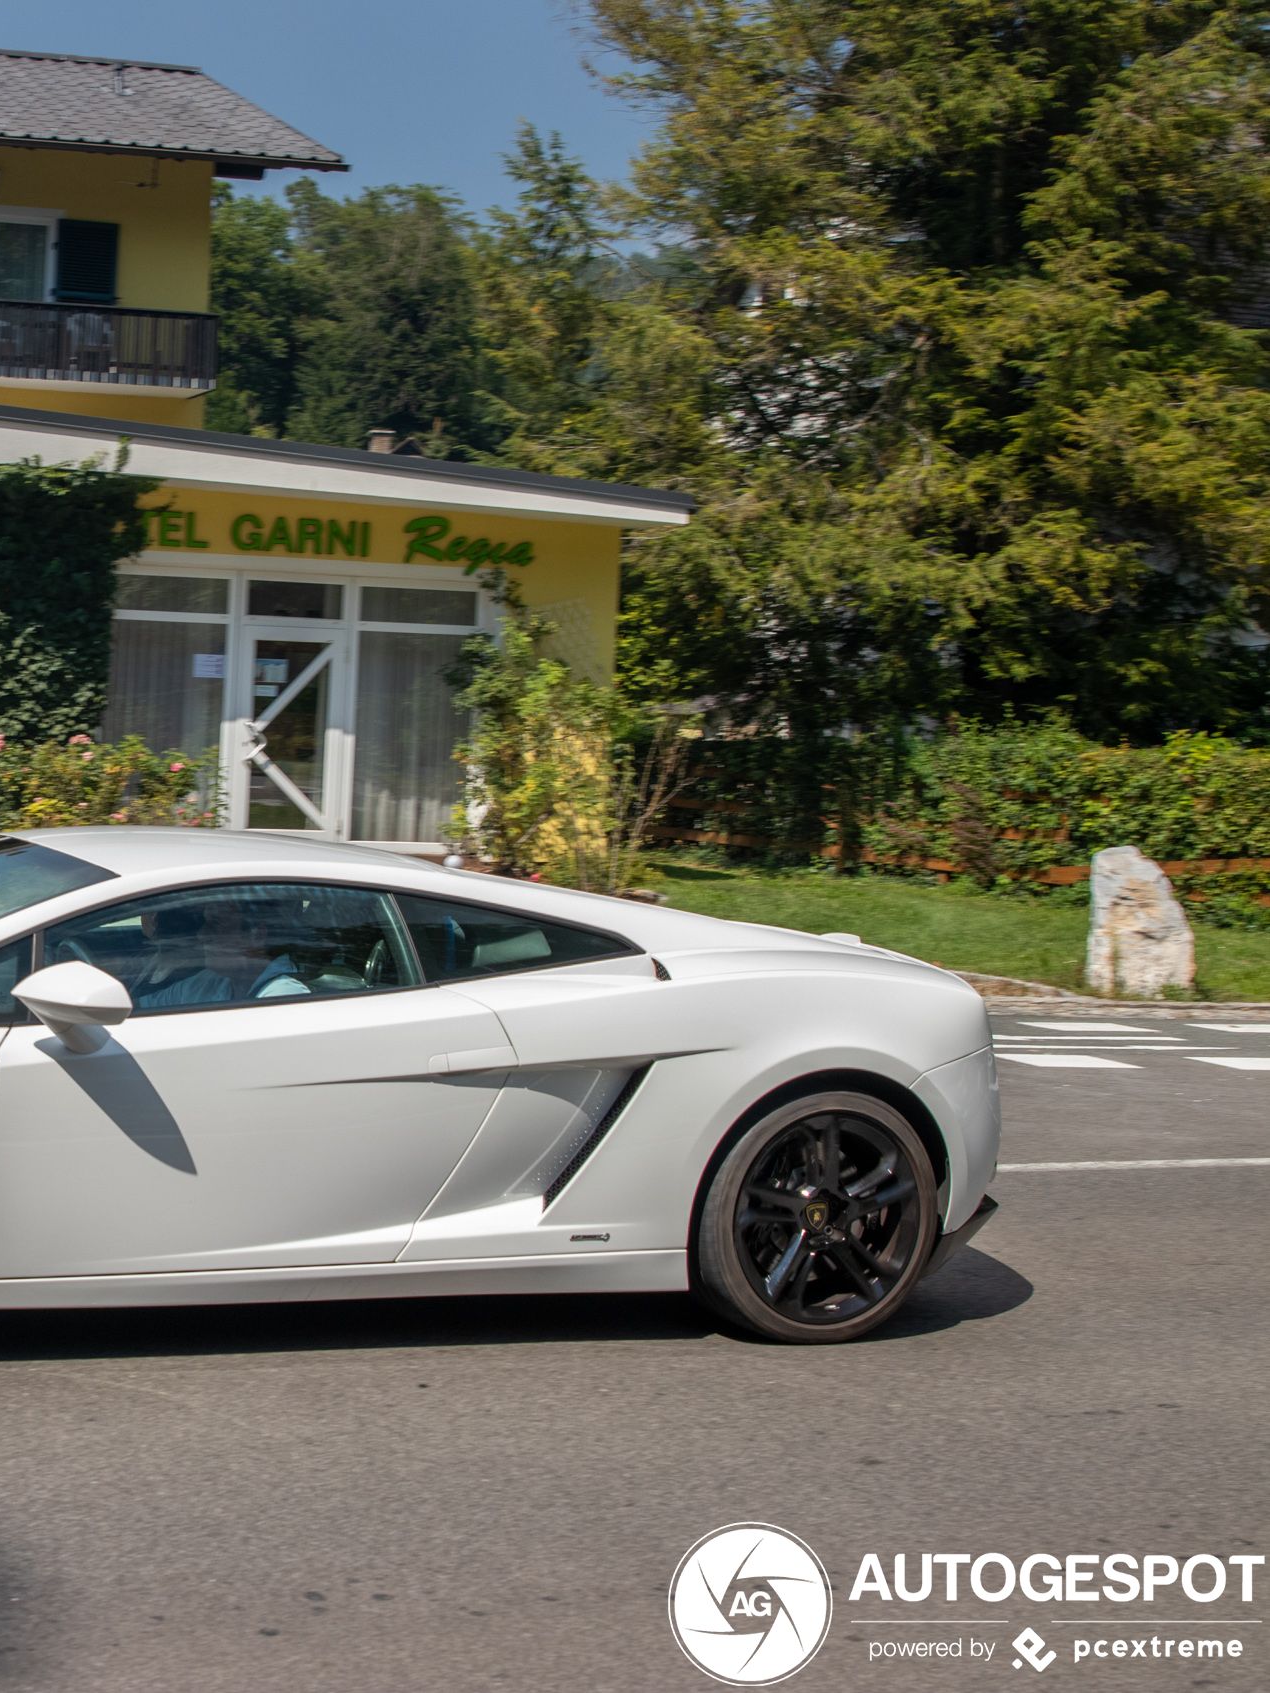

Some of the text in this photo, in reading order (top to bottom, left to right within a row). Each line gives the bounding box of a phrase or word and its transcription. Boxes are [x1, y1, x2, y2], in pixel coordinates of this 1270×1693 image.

[141, 510, 534, 576] TEL GARNI Regia
